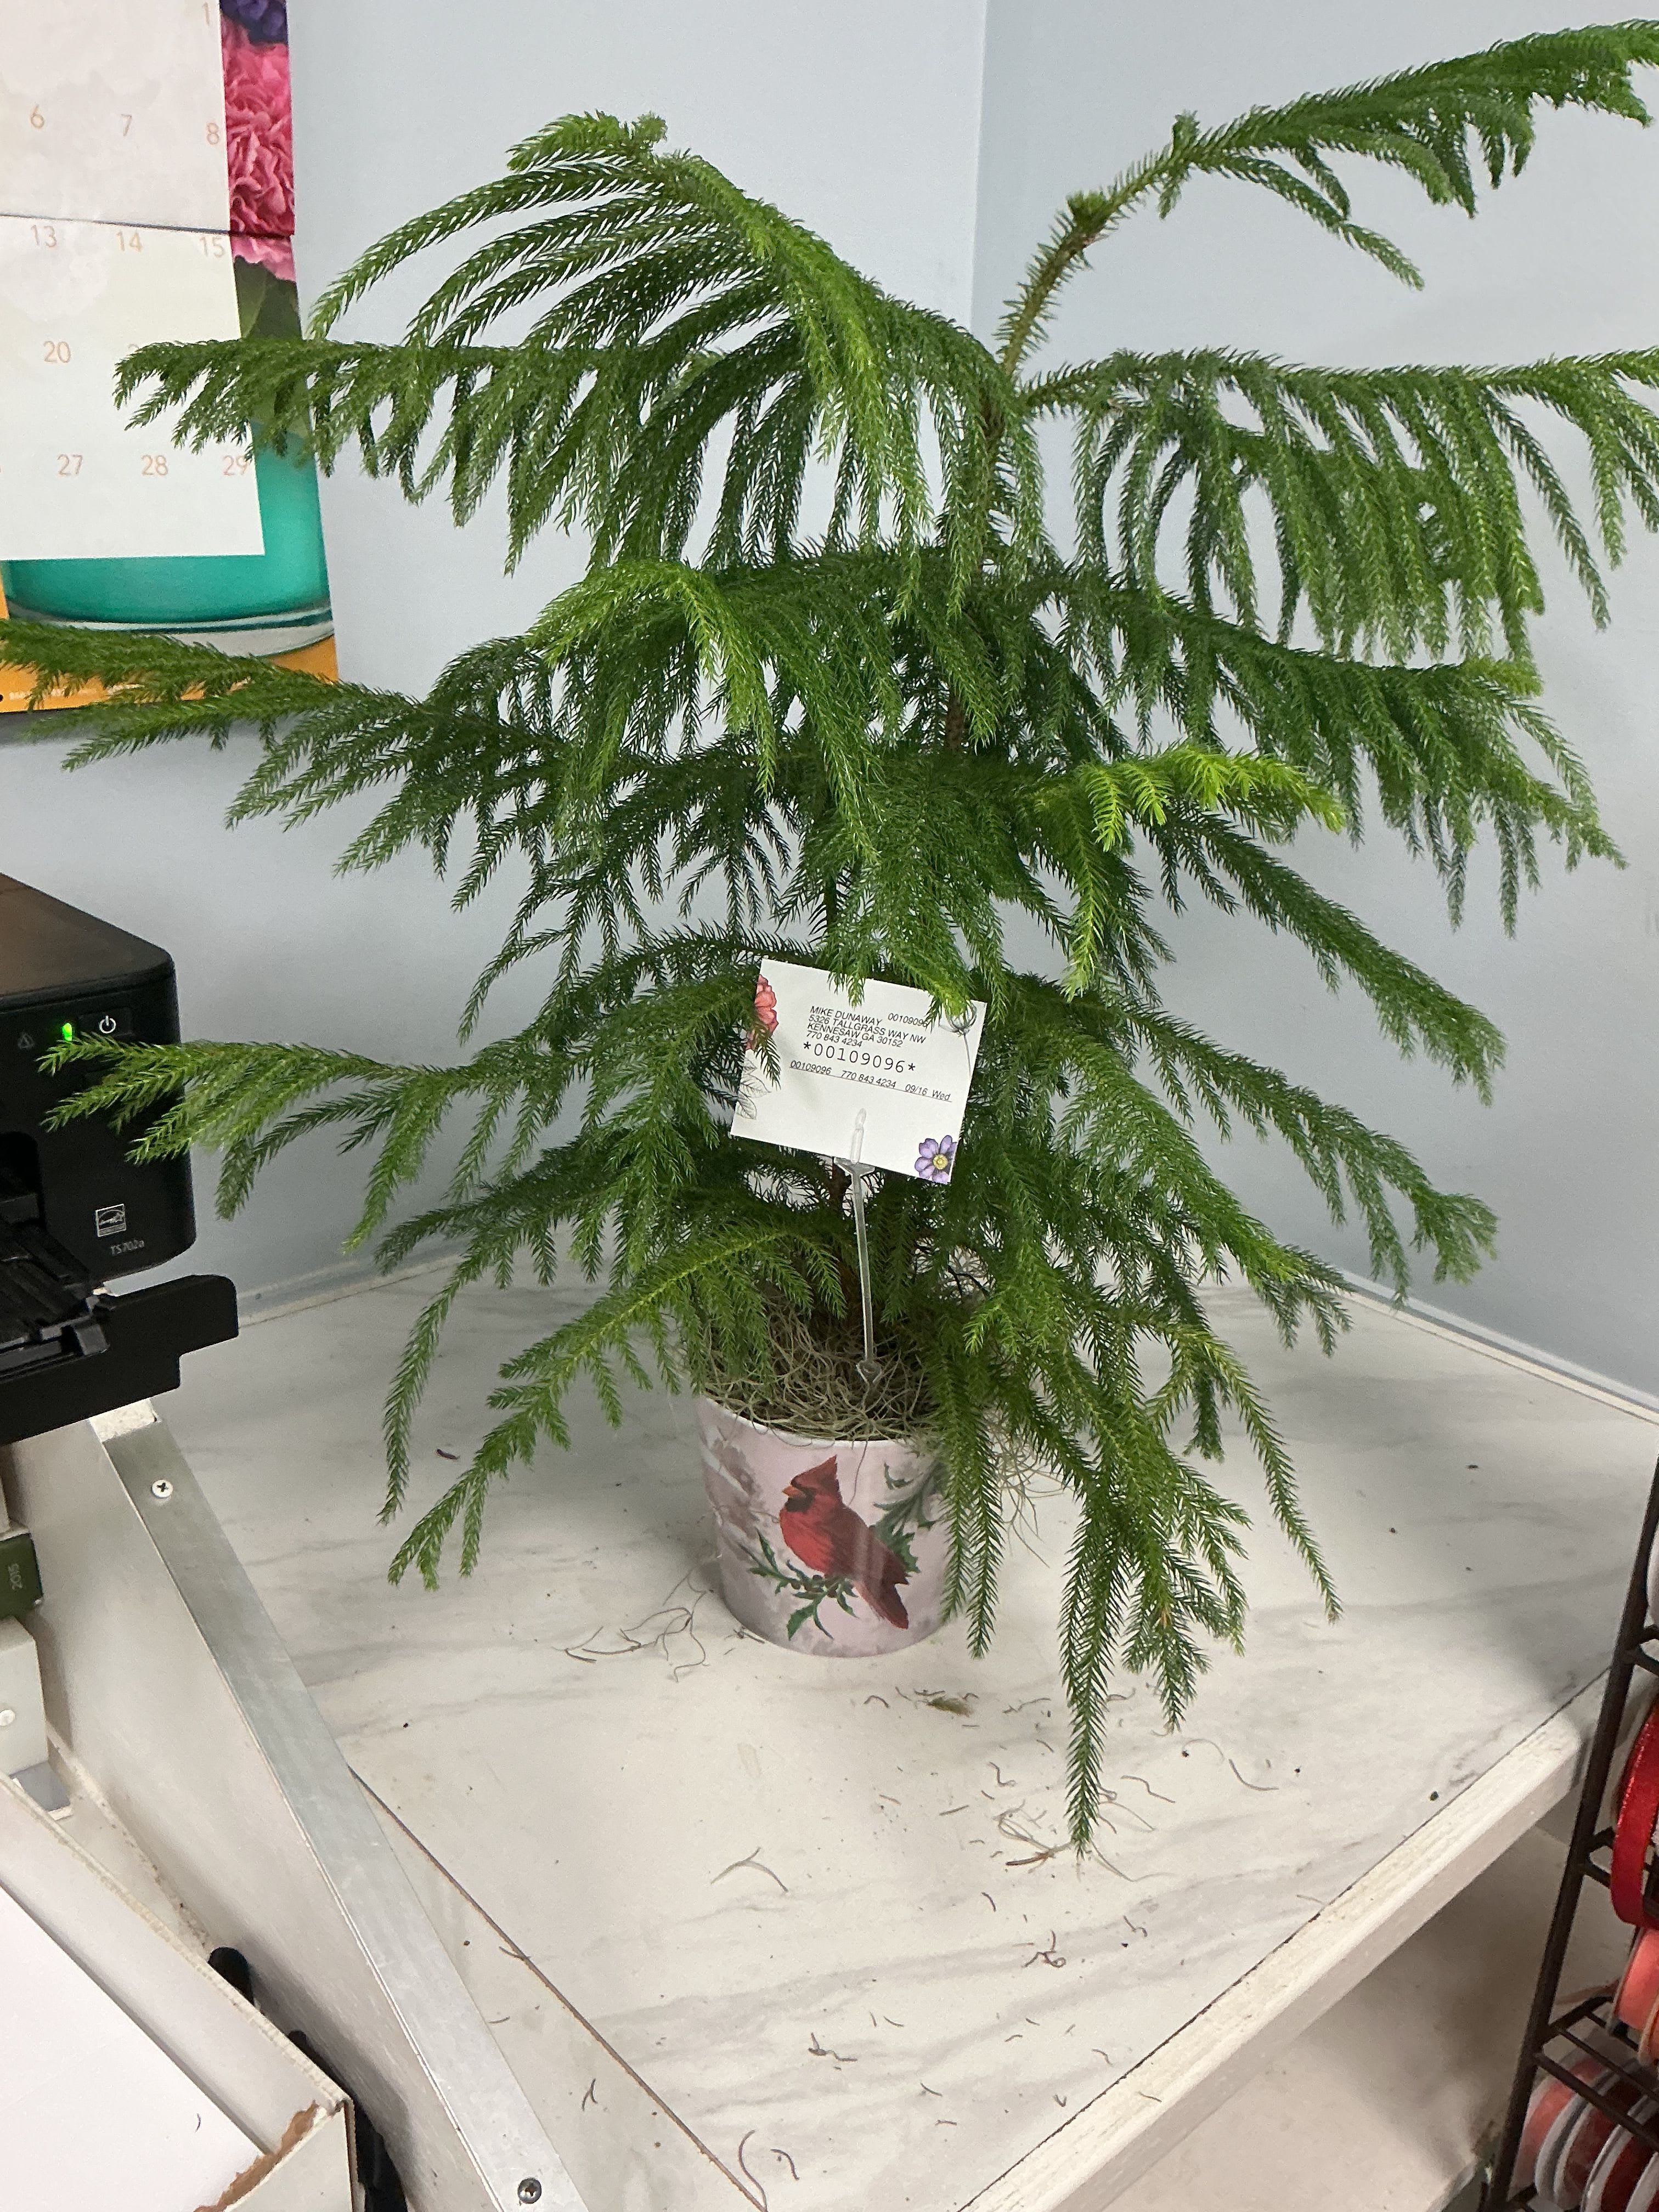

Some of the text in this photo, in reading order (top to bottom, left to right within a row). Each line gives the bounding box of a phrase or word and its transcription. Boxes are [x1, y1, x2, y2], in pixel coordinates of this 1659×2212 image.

[201, 2, 210, 26] 1
[31, 104, 219, 145] 6 7 8
[31, 224, 226, 258] 13 14 15
[43, 341, 71, 363] 20
[57, 454, 249, 476] 27 28 29
[809, 1015, 926, 1043] 5326 TALLGRASS WAY NW
[810, 1006, 928, 1028] MIKE DUNAWAY 00109096
[806, 1030, 862, 1047] 770 843 4234
[807, 1023, 903, 1047] KENNESAW GA 30152
[790, 1060, 951, 1101] 00109096 770 843 4234 09/16 Wed
